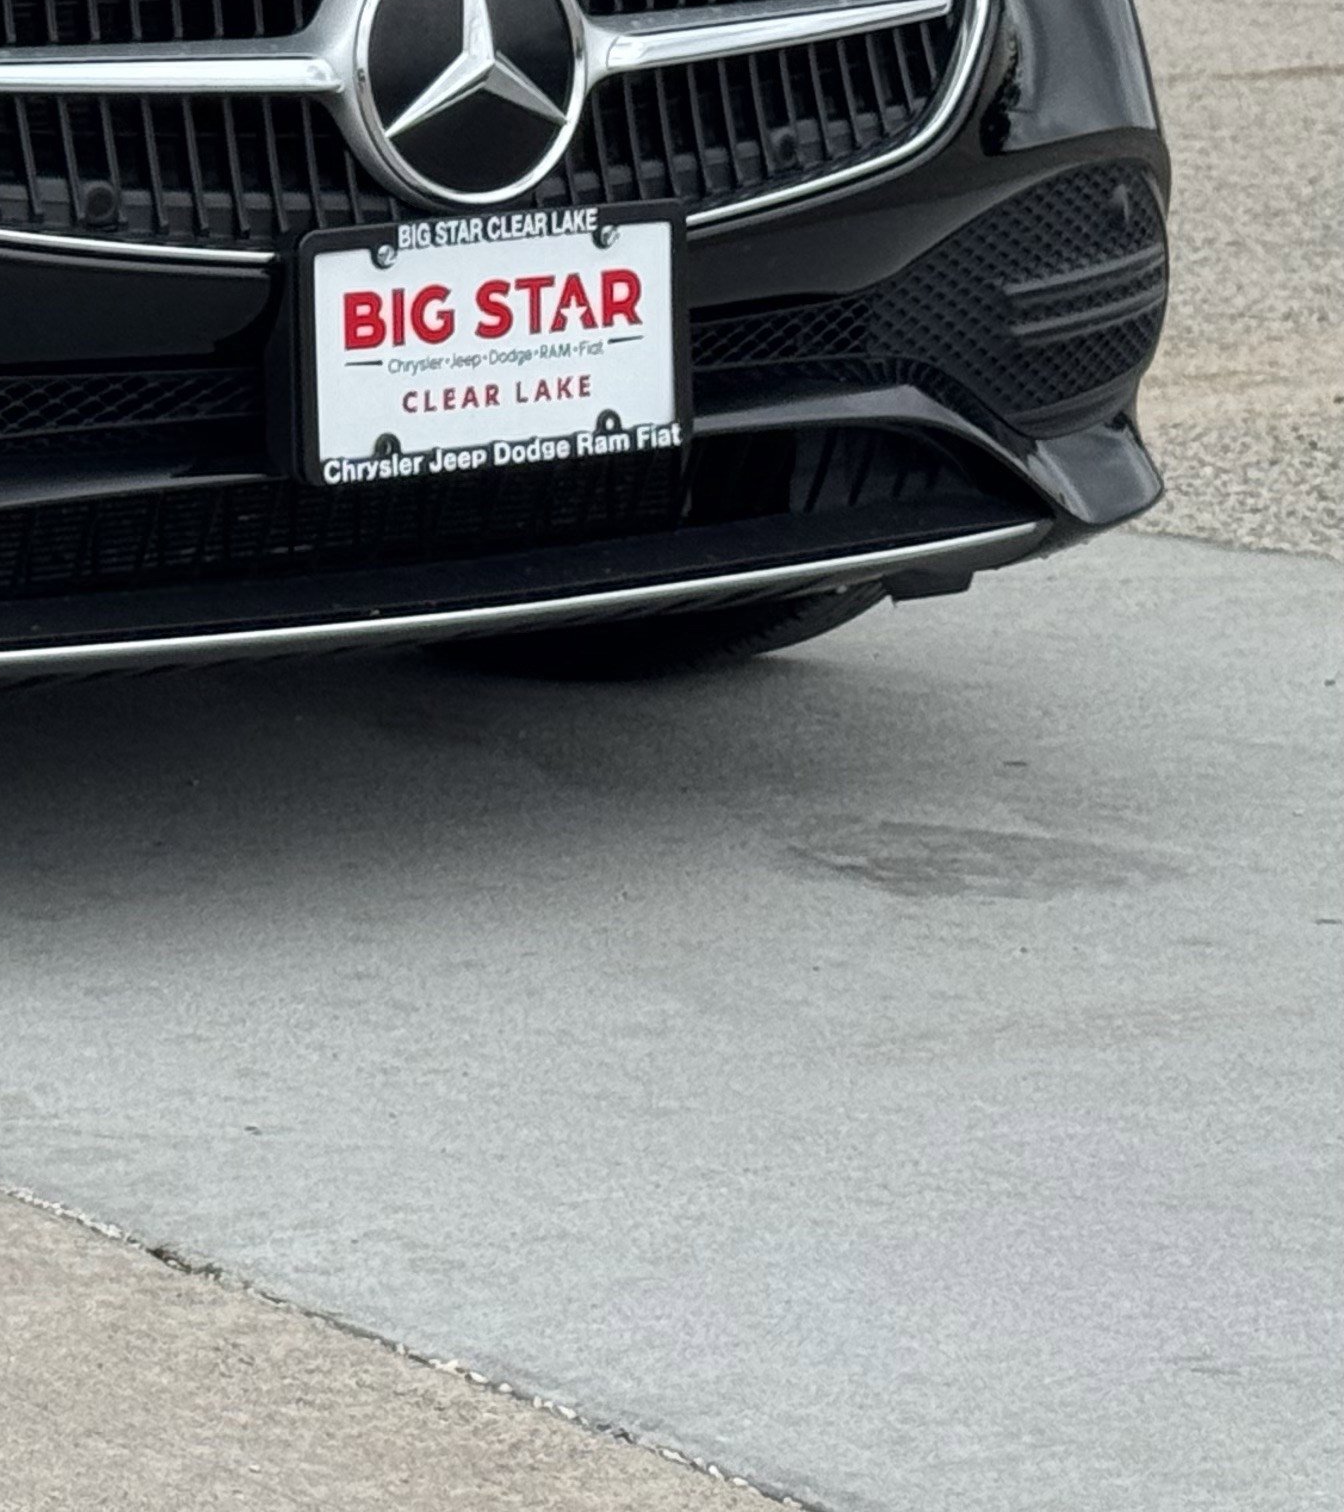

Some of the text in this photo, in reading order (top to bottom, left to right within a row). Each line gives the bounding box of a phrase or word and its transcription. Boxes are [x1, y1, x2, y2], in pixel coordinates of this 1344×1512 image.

[398, 208, 598, 248] BIG STAR CLEAR LAKE
[343, 268, 644, 351] BIG STAR
[402, 374, 591, 413] CLEAR LAKE
[323, 423, 682, 485] Chrysler Jeep Dodge Ram Fiat
